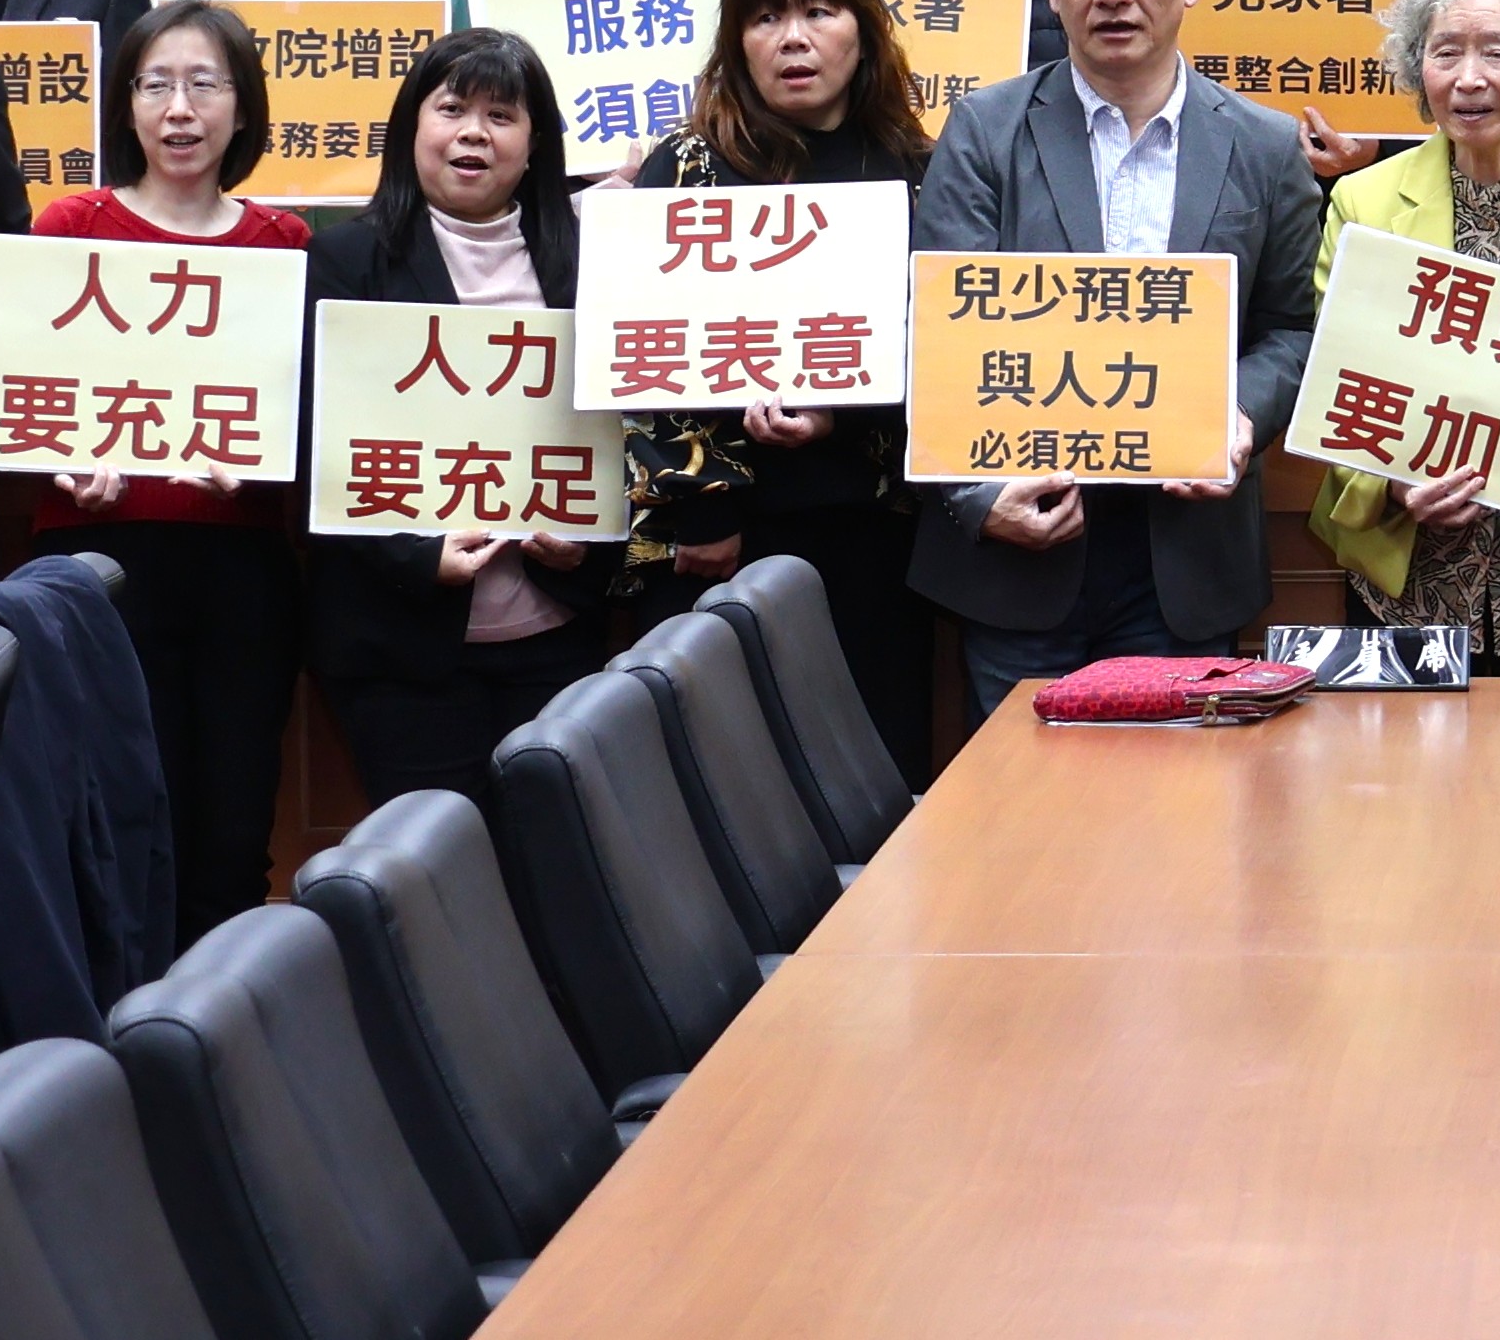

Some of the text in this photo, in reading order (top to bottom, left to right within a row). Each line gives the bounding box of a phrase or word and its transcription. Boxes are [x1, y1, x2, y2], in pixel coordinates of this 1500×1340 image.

[1193, 55, 1396, 97] 要整合創新
[561, 78, 700, 144] 須創
[21, 147, 95, 186] 員會
[660, 196, 829, 275] 兒少
[51, 252, 222, 337] 人力
[948, 265, 1193, 325] 兒少預算
[395, 315, 556, 399] 人力
[610, 313, 872, 398] 要表意
[978, 351, 1159, 411] 與人力
[346, 438, 598, 525] 要充足
[969, 429, 1152, 474] 必須充足
